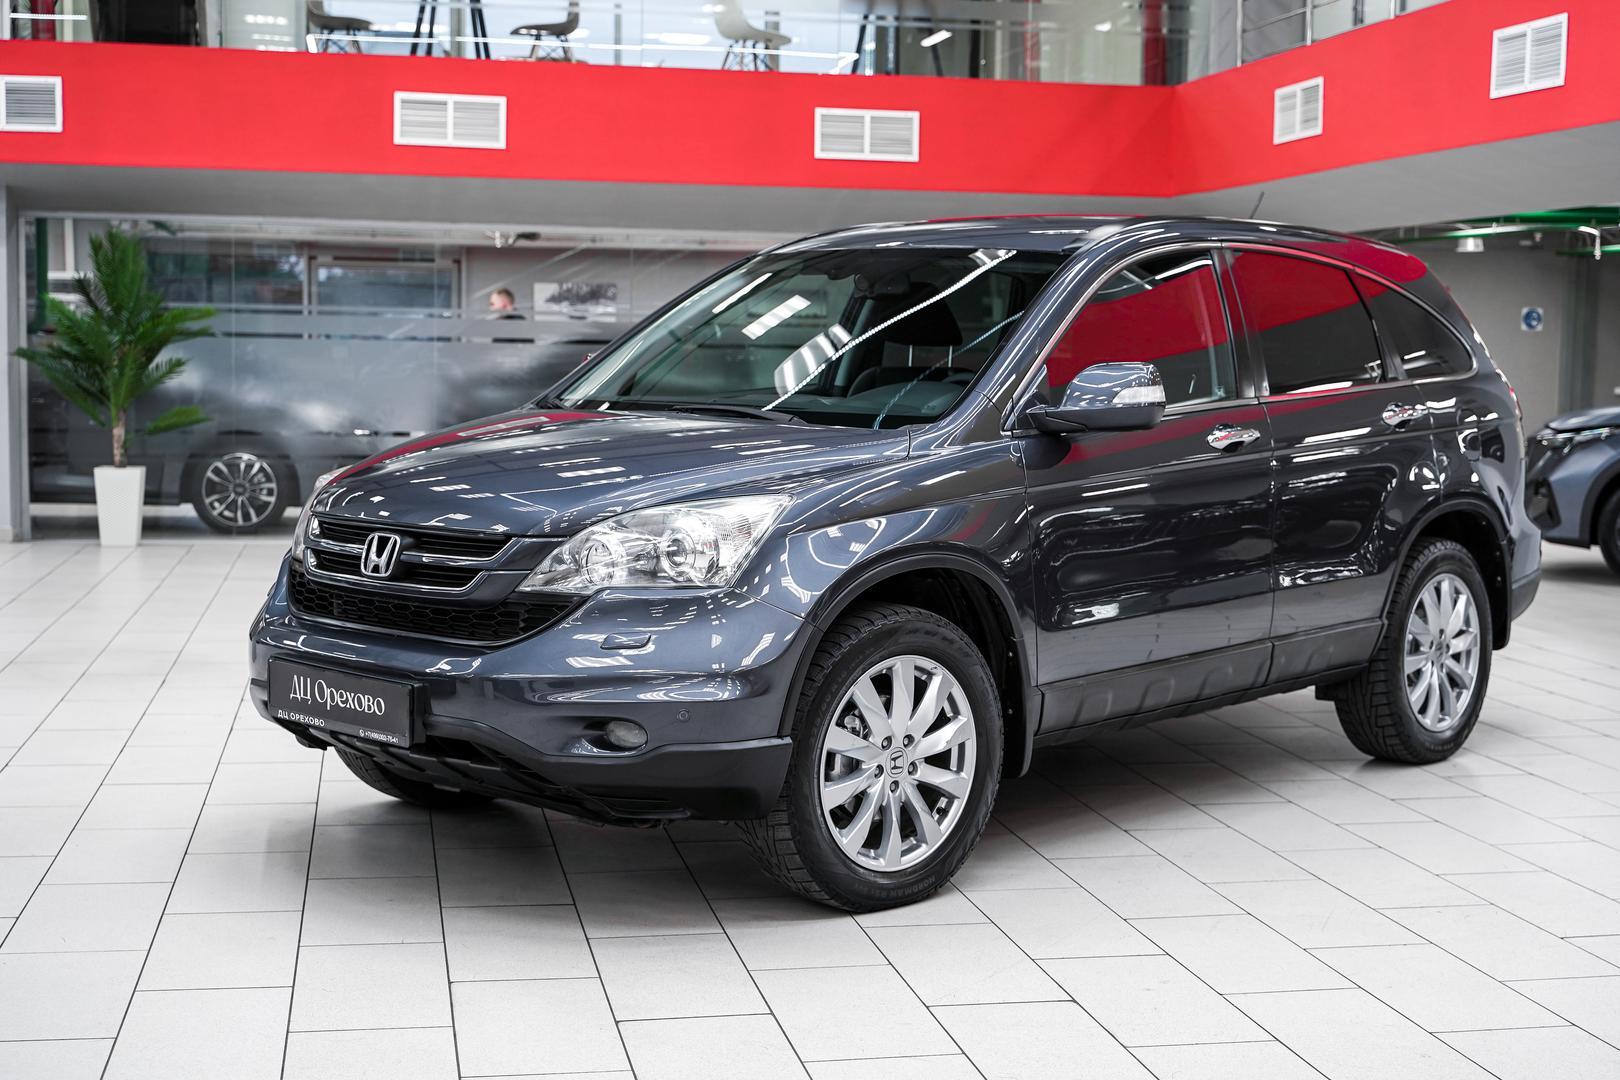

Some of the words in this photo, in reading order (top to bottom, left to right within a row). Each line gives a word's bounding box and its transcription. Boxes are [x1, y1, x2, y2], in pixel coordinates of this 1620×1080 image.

[290, 675, 311, 704] ДЦ
[315, 680, 385, 715] Орехово
[278, 709, 289, 720] ДЦ
[290, 712, 325, 727] ОРЕХОВО
